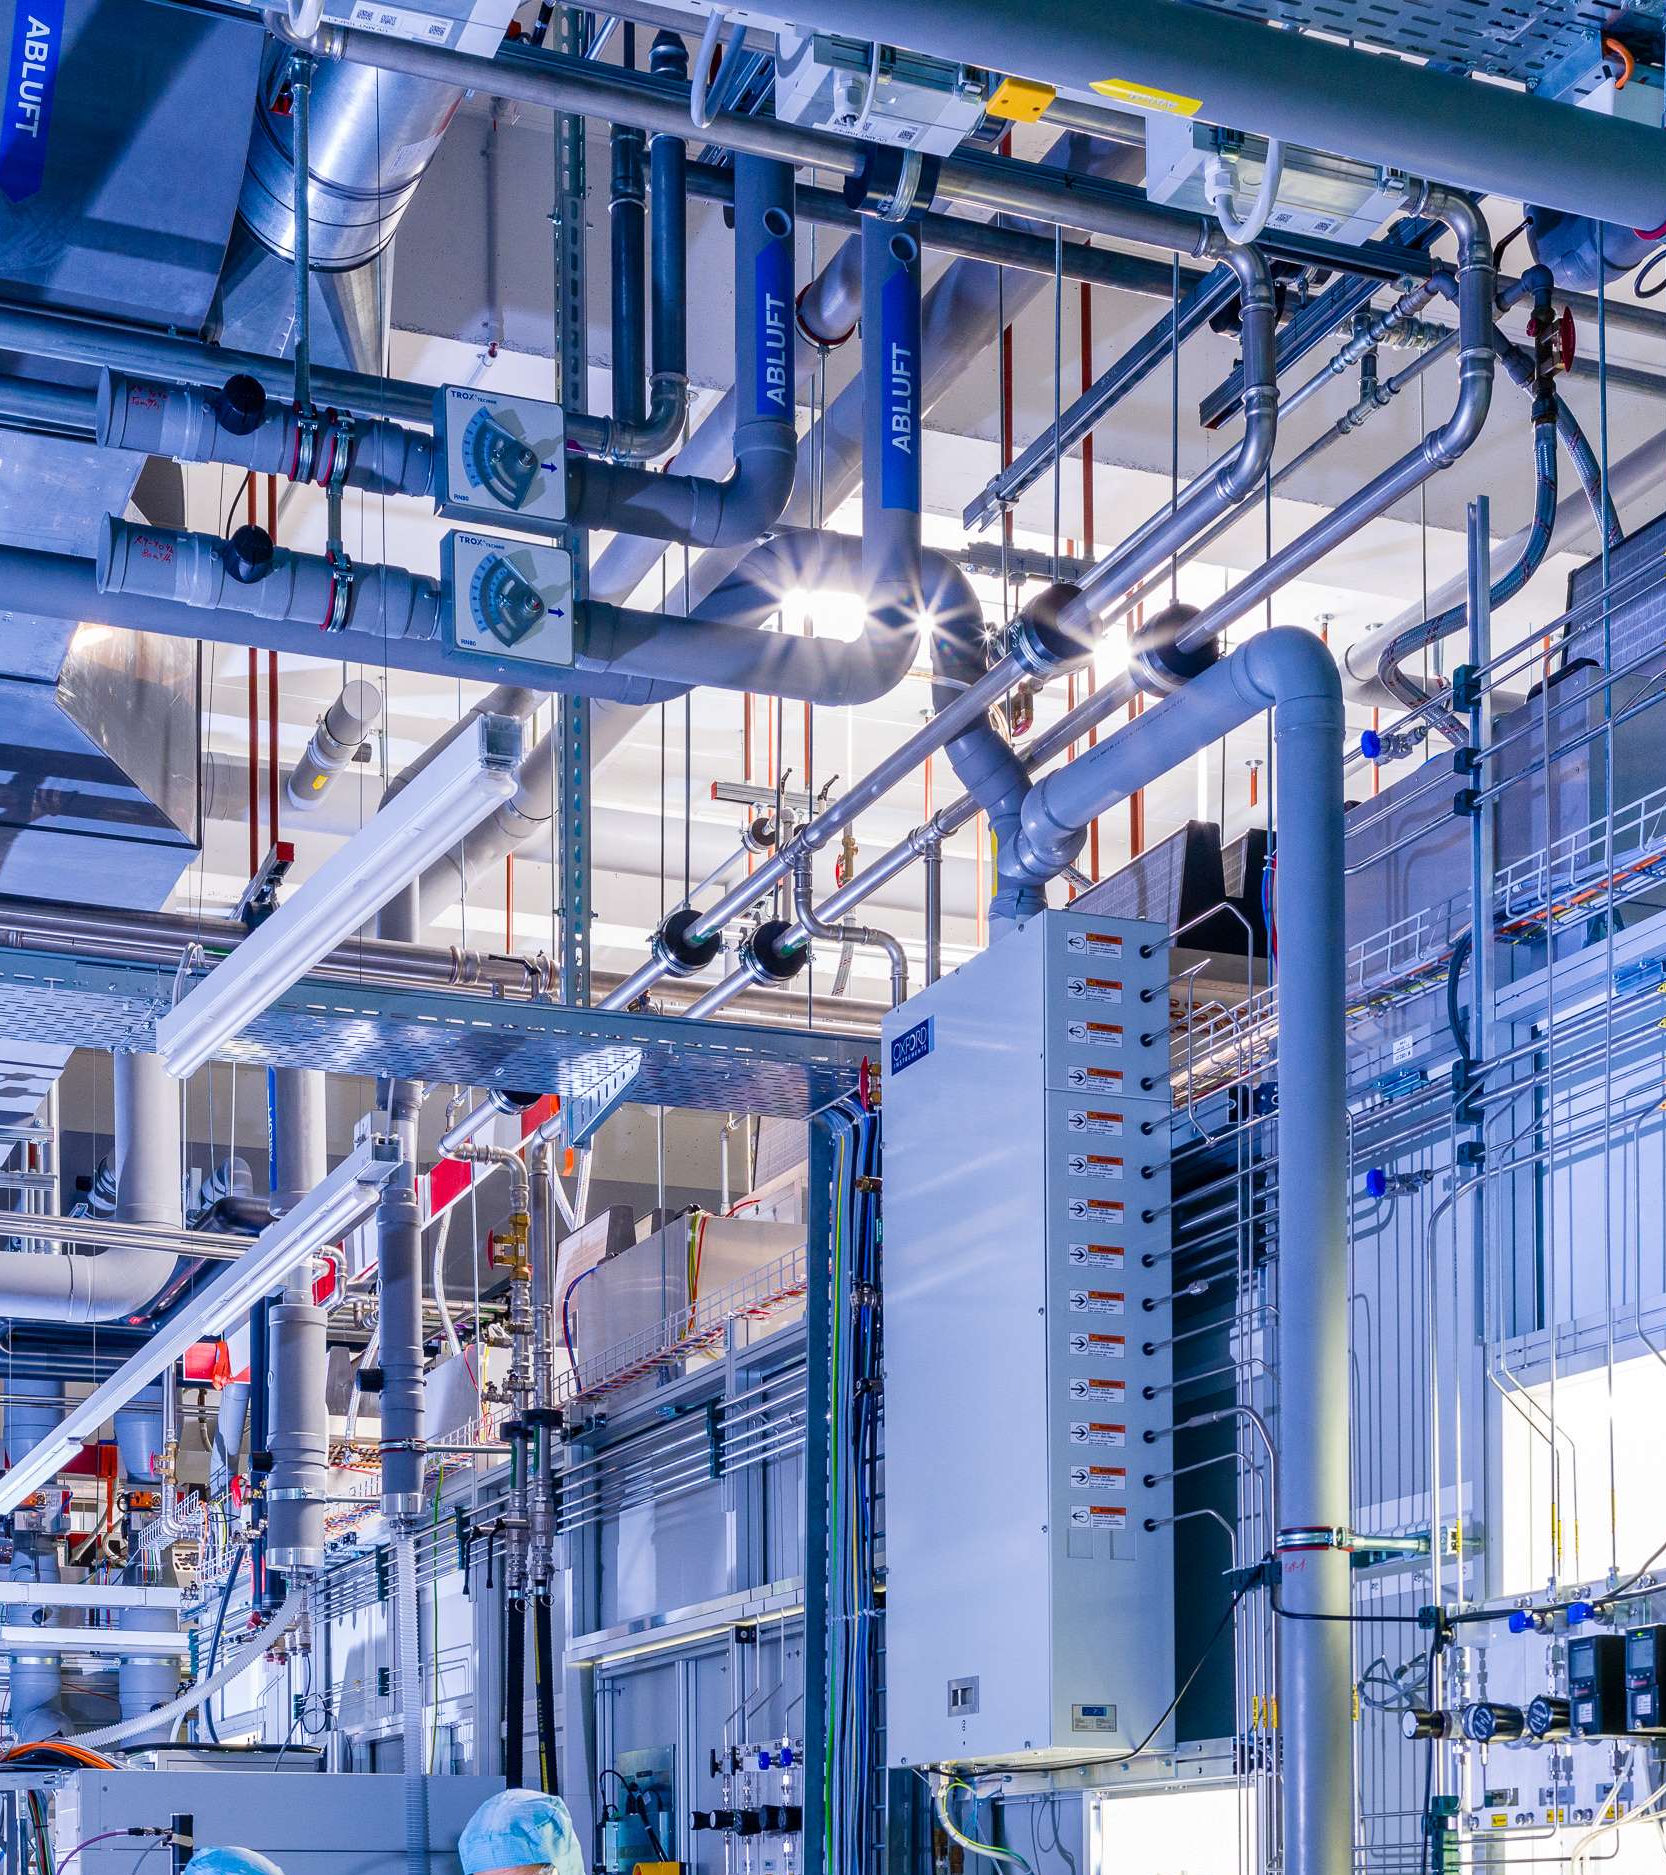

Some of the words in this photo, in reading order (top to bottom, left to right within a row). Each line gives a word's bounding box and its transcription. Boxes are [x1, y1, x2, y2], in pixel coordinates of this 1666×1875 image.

[15, 15, 51, 138] ABLUFT
[765, 292, 786, 407] ABLUFT
[451, 390, 474, 401] TROX
[892, 342, 911, 454] ABLUFT
[459, 535, 482, 546] TROX
[893, 1026, 928, 1060] OXFORD
[893, 1044, 927, 1069] INSTRUMENTS
